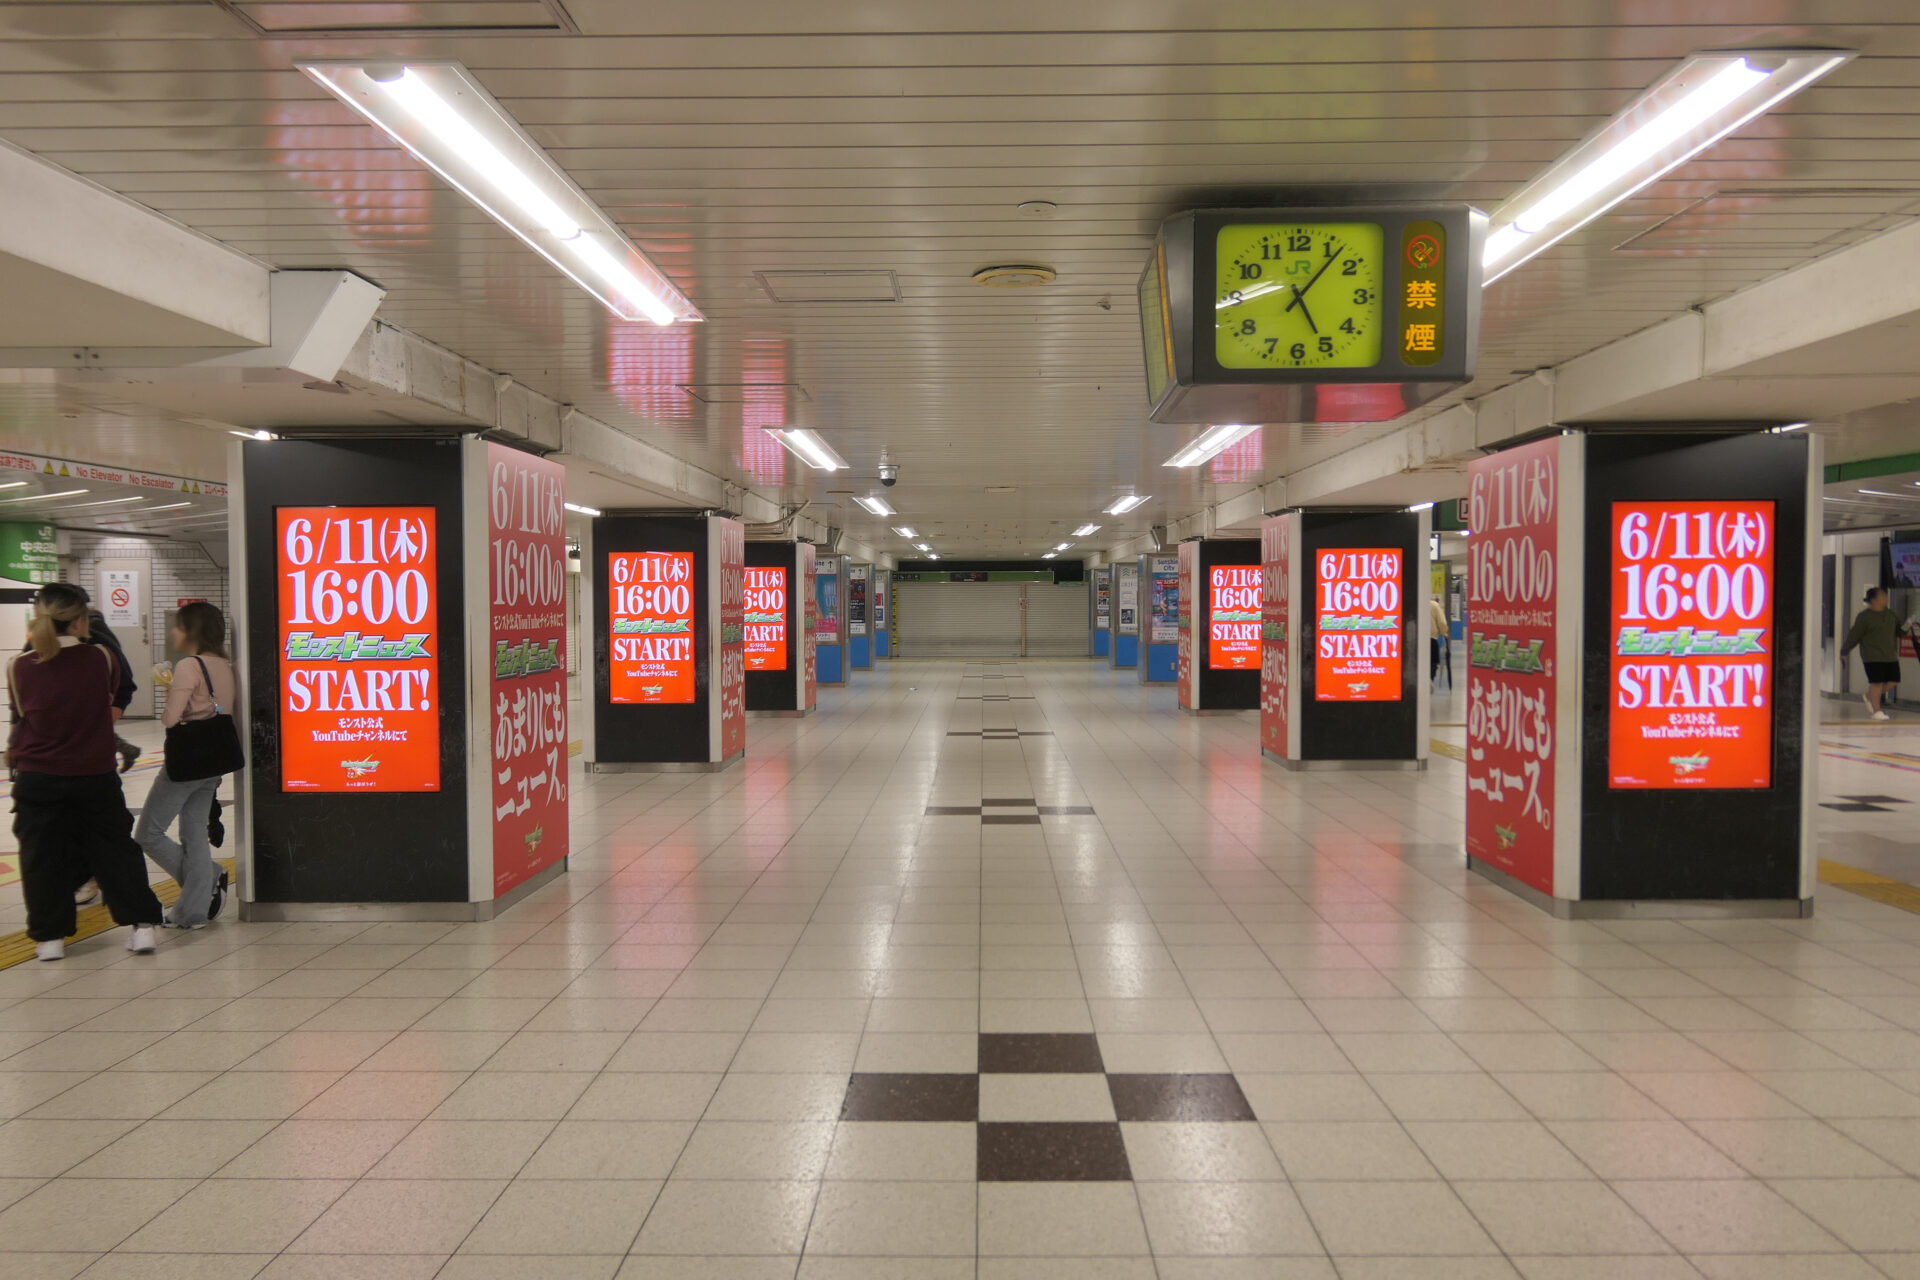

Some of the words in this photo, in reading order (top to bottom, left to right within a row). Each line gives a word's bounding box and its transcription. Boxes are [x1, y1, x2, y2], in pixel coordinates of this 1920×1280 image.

[1261, 244, 1281, 260] 11
[1287, 235, 1311, 251] 12
[1322, 242, 1332, 258] 1
[1240, 263, 1262, 279] 10
[1286, 260, 1311, 275] JR
[1342, 259, 1357, 276] 2
[1353, 288, 1368, 305] 3
[1241, 319, 1256, 335] 8
[1339, 317, 1355, 334] 4
[1405, 280, 1436, 351] 禁煙
[1264, 338, 1279, 354] 7
[1290, 343, 1305, 359] 6
[1318, 336, 1333, 353] 5
[76, 467, 88, 477] No
[90, 468, 123, 482] Elevator
[129, 474, 140, 485] No
[141, 476, 175, 489] Escalator
[492, 461, 563, 537] 6/11(木)
[1471, 456, 1554, 534] 6/11(木)
[285, 516, 428, 564] 6/11(木)
[1619, 512, 1766, 560] 6/11(木)
[493, 538, 564, 607] 16:00の
[613, 557, 690, 583] 6/11(木)
[1320, 554, 1398, 579] 6/11(木)
[1470, 535, 1553, 602] 16:00の
[287, 569, 430, 625] 16:00
[613, 585, 690, 615] 16:00
[1321, 581, 1398, 611] 16:00
[1620, 563, 1766, 620] 16:00
[285, 631, 432, 662] モンストニュース
[613, 638, 690, 661] START!
[1320, 634, 1398, 658] START!
[1616, 626, 1767, 657] モンストニュース
[288, 668, 430, 712] START!
[1618, 664, 1765, 709] START!
[338, 716, 384, 729] モンスト公式
[496, 681, 565, 761] あまりにも
[1469, 677, 1551, 760] あまりにも
[312, 729, 407, 742] YouTubeチャンネルにて
[497, 746, 566, 821] ニュース。
[1469, 747, 1551, 830] ニュース。
